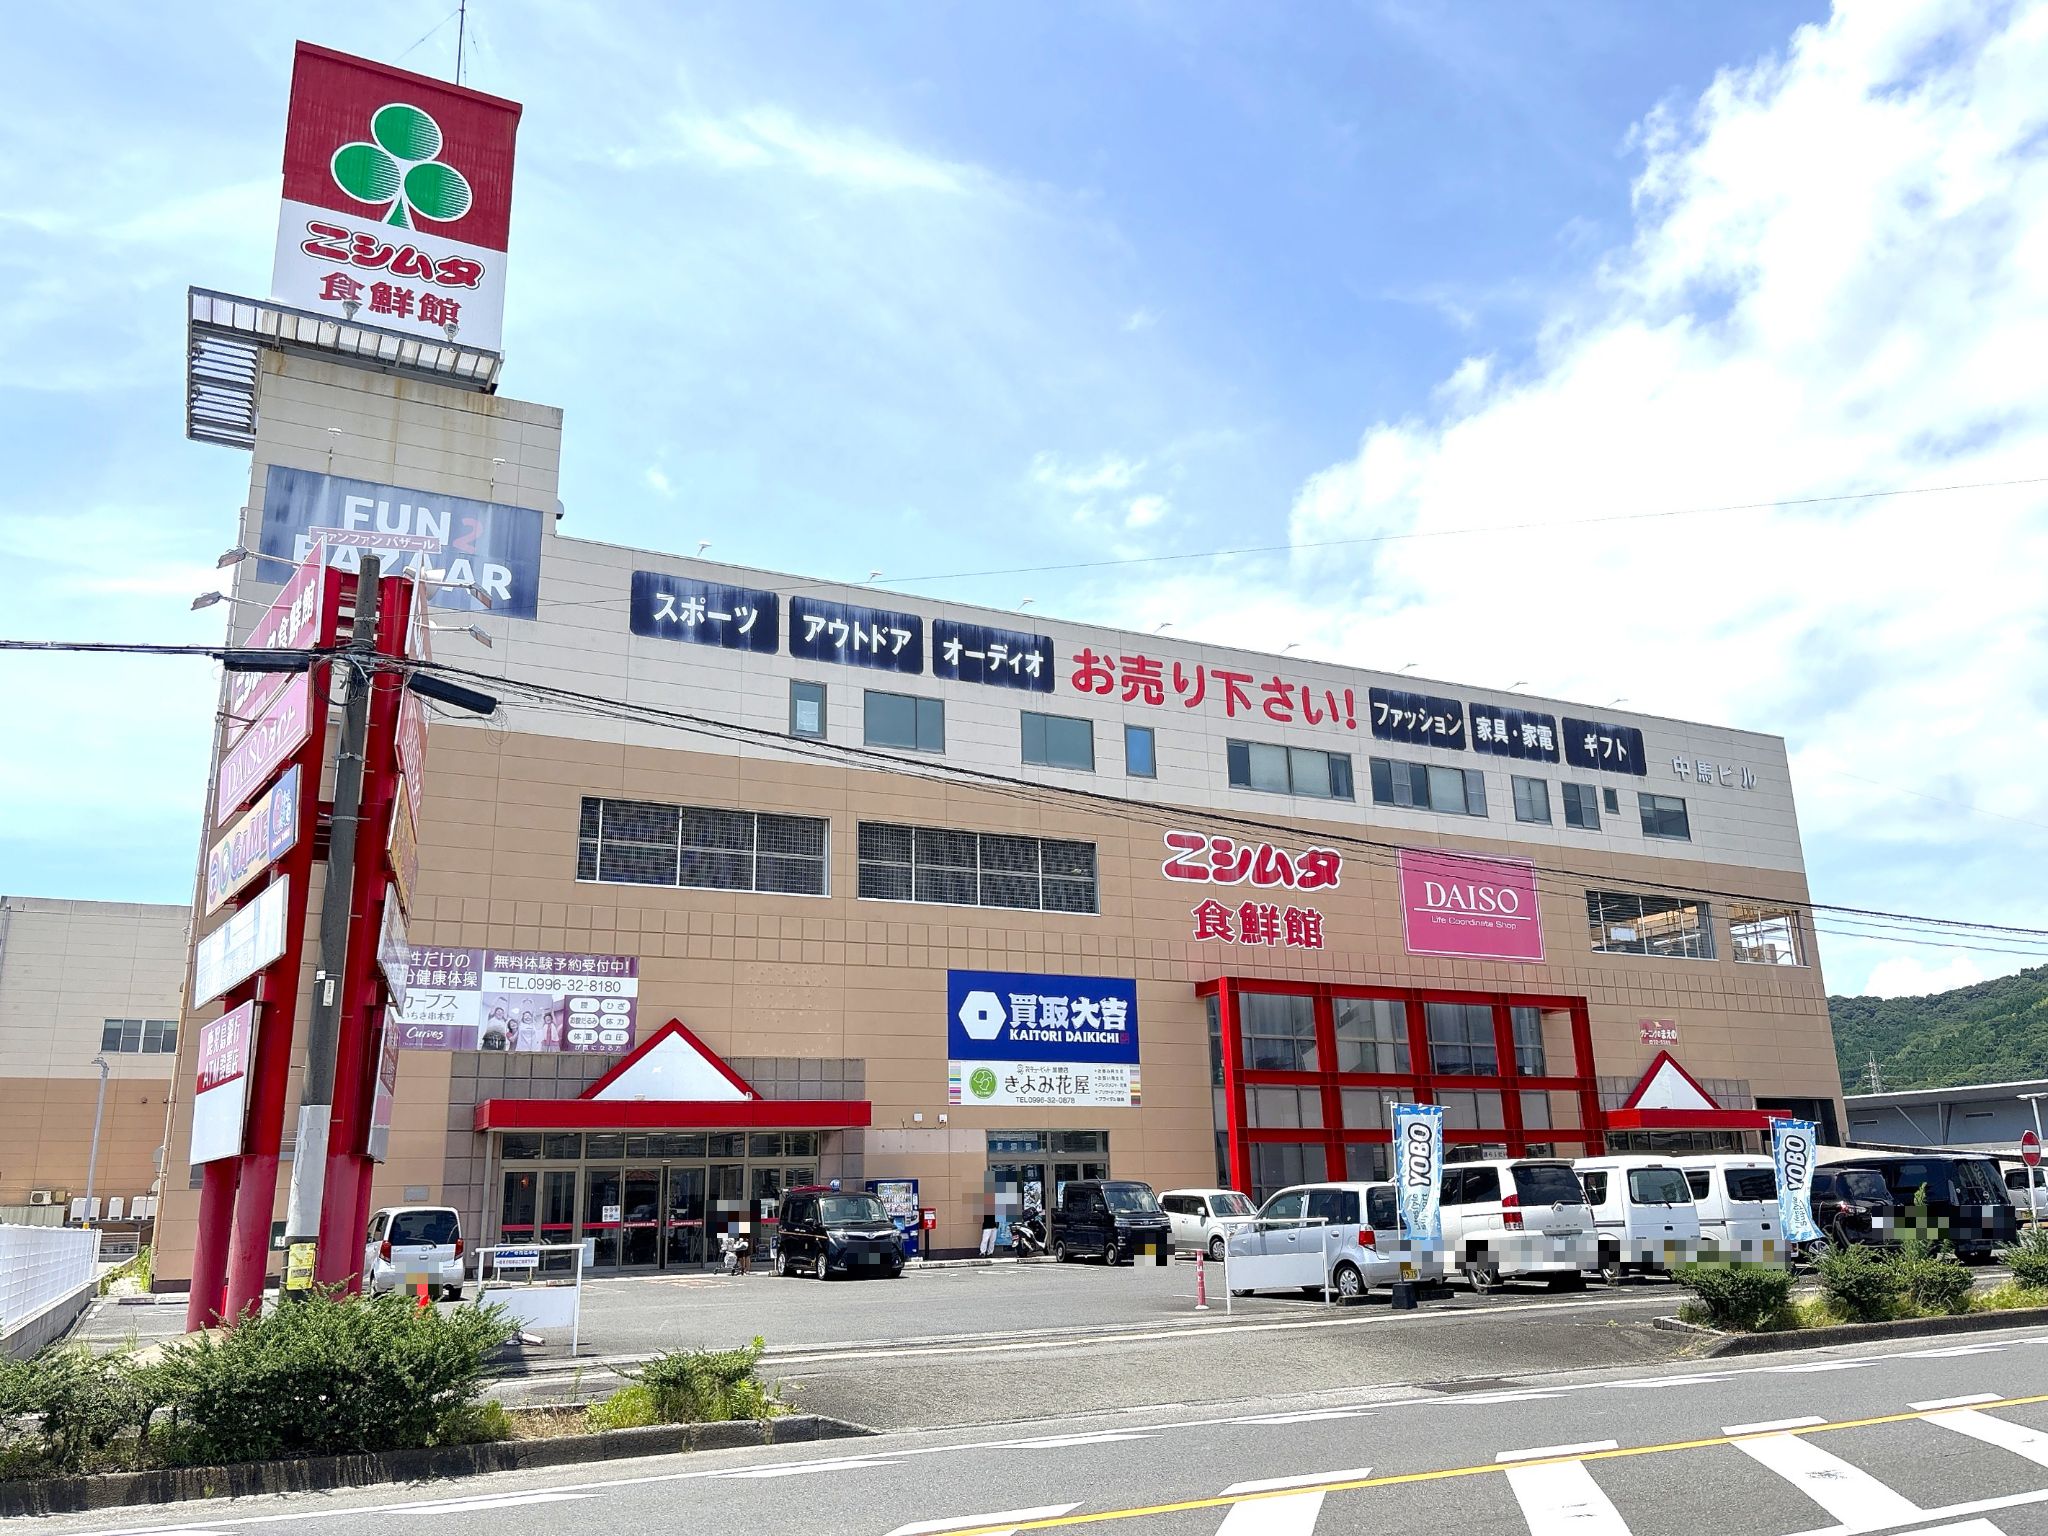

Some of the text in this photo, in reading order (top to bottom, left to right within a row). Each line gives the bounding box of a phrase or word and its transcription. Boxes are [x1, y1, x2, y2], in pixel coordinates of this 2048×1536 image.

[301, 220, 485, 290] ニシムタ
[319, 272, 461, 328] 食鮮館
[344, 495, 482, 553] FUN 2
[385, 536, 436, 551] バザール
[653, 592, 758, 635] スポーツ
[802, 613, 913, 656] アウトドア
[943, 635, 1045, 678] オーディオ
[1071, 647, 1357, 730] お売り下さい!
[1372, 701, 1462, 737] ファッション
[1475, 716, 1555, 752] 家具・家電
[1583, 732, 1628, 762] ギフト
[1671, 755, 1758, 791] 中馬ビル
[1162, 830, 1343, 892] ニシムタ
[1424, 881, 1519, 914] DAISO
[1191, 897, 1325, 950] 食鮮館
[1431, 915, 1517, 930] Life Coordinate Shop
[494, 954, 630, 975] 無料体験予約受付中!
[499, 976, 621, 994] TEL.0996-32-8180
[1008, 992, 1129, 1031] 買取大吉
[406, 1026, 444, 1041] Curves
[1009, 1028, 1062, 1042] KAITORI
[1065, 1030, 1120, 1044] DAIKICHI
[1004, 1074, 1091, 1095] きよみ花屋
[1407, 1121, 1433, 1187] YOBO
[1784, 1134, 1807, 1191] YOBO
